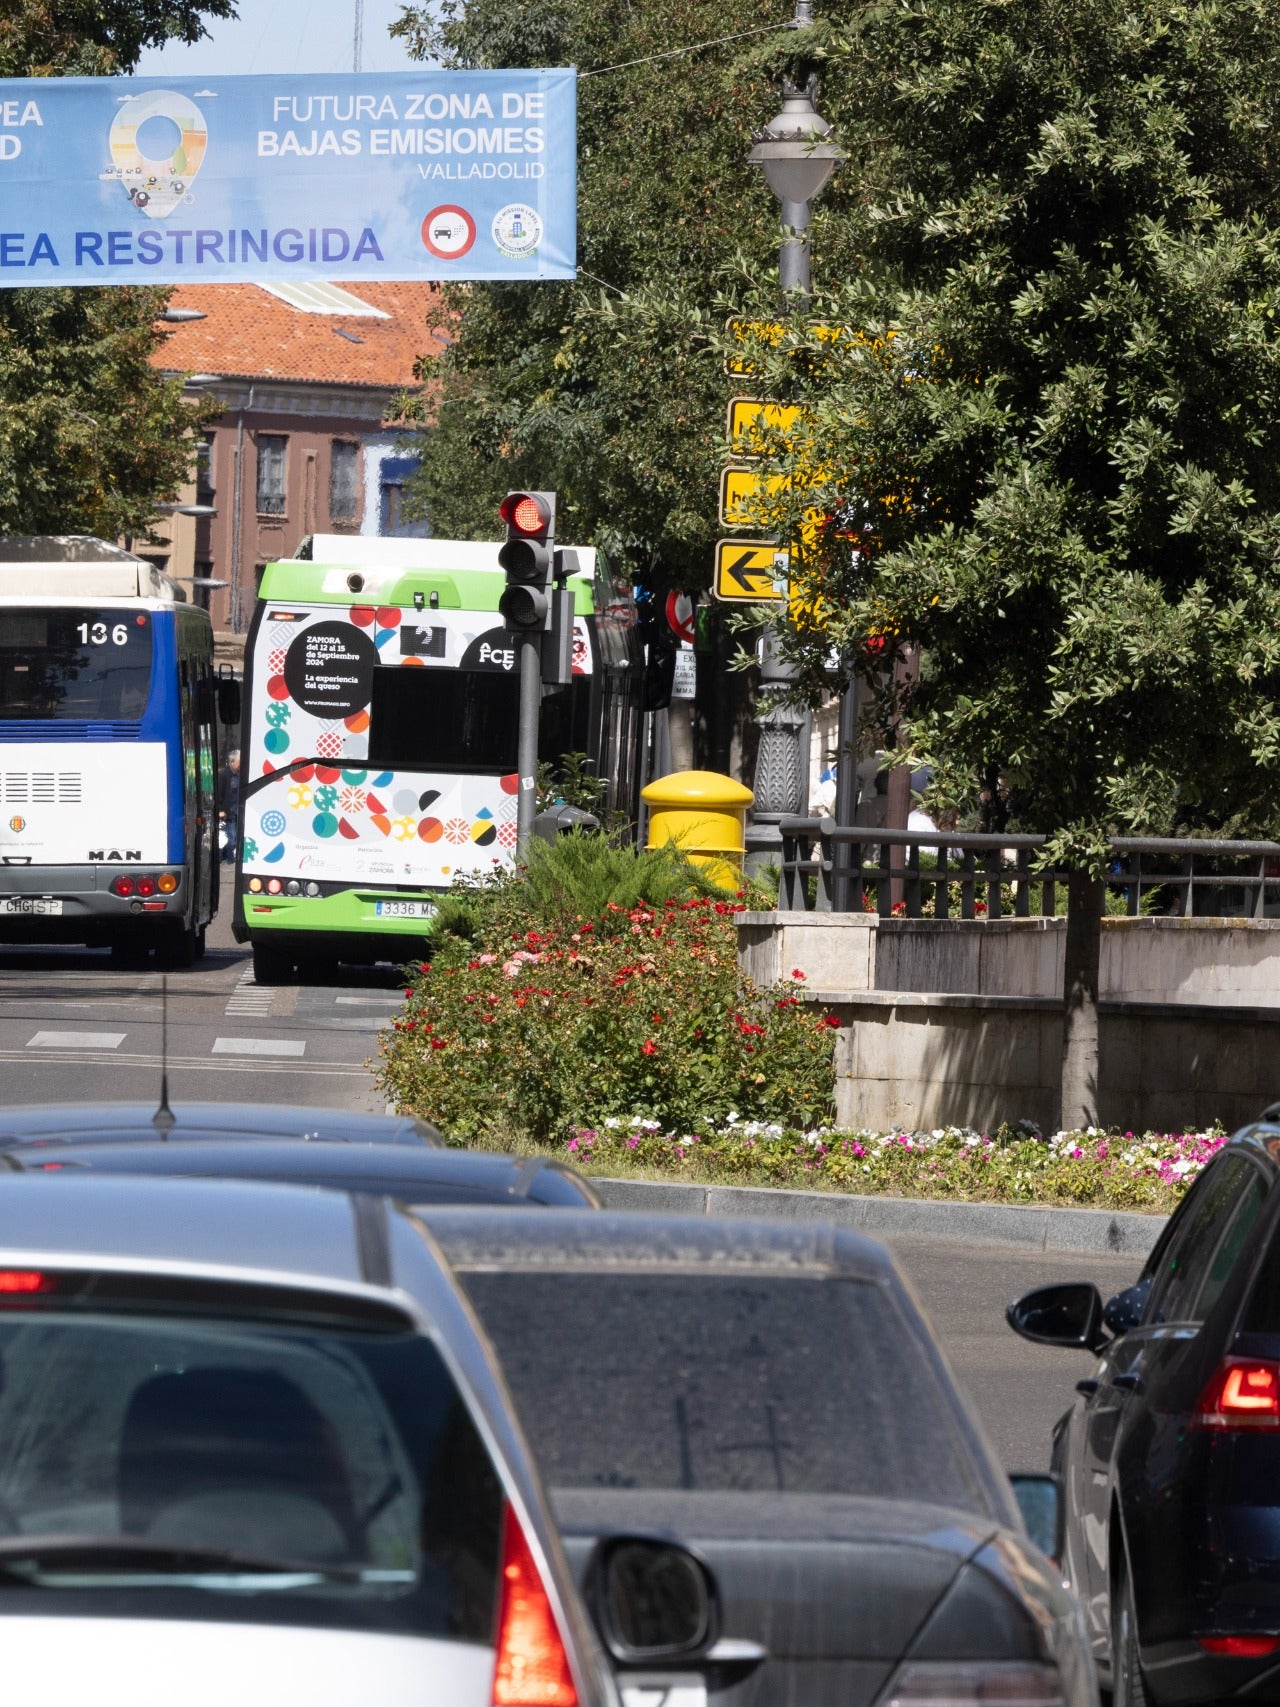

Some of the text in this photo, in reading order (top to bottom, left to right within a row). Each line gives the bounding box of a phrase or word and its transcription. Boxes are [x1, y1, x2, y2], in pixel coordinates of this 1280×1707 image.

[273, 92, 545, 122] FUTURA ZONA DE
[257, 127, 545, 157] BAJAS EMISIOMES
[418, 161, 545, 180] VALLADOLID
[74, 227, 385, 267] RESTRINGIDA
[76, 622, 129, 646] 136
[306, 635, 341, 644] ZAMORA
[306, 643, 319, 651] del
[329, 644, 336, 652] al
[305, 651, 360, 661] de Septiembre
[305, 658, 324, 666] 2024
[305, 674, 359, 684] La experiencia
[317, 683, 341, 691] queso
[88, 850, 142, 862] MAN
[384, 902, 416, 916] 3336
